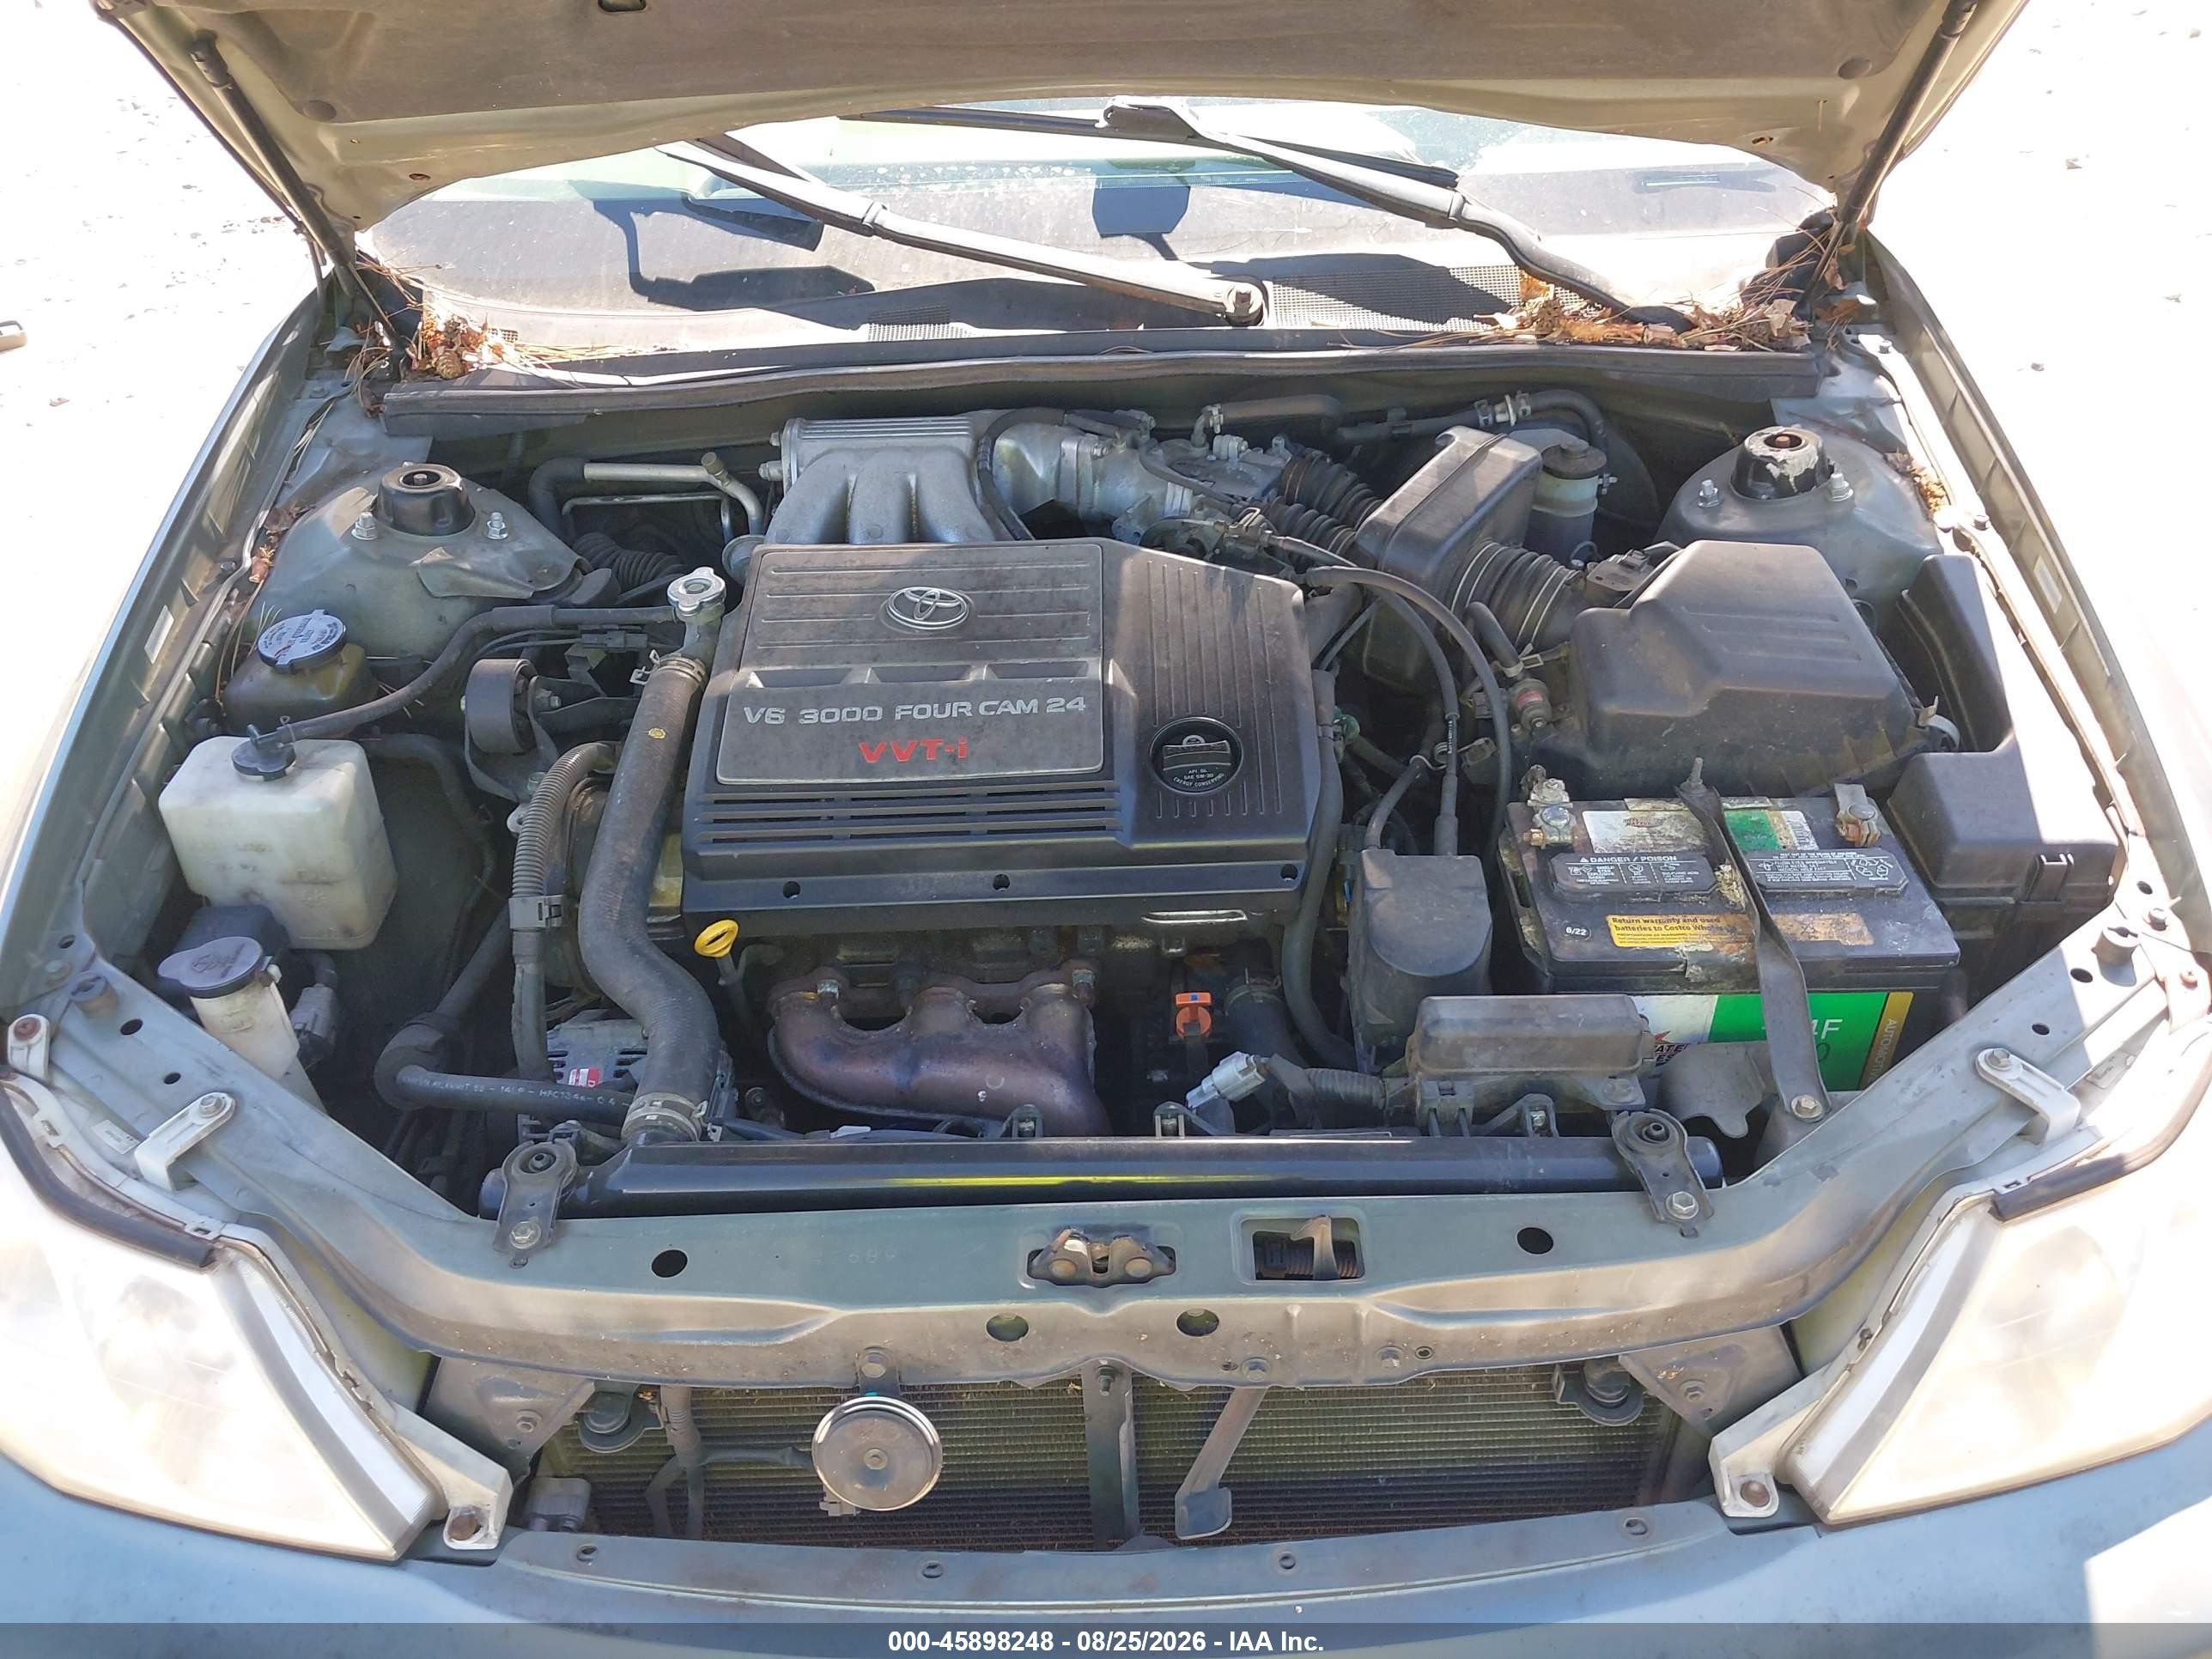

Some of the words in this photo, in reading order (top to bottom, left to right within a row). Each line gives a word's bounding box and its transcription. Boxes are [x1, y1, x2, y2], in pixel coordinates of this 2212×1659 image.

[743, 706, 786, 725] V6
[798, 705, 883, 724] 3000
[894, 701, 973, 720] FOUR
[978, 699, 1038, 716] CAM
[1046, 696, 1086, 714] 24
[858, 737, 968, 763] VVT-i
[1565, 927, 1588, 936] 6/22
